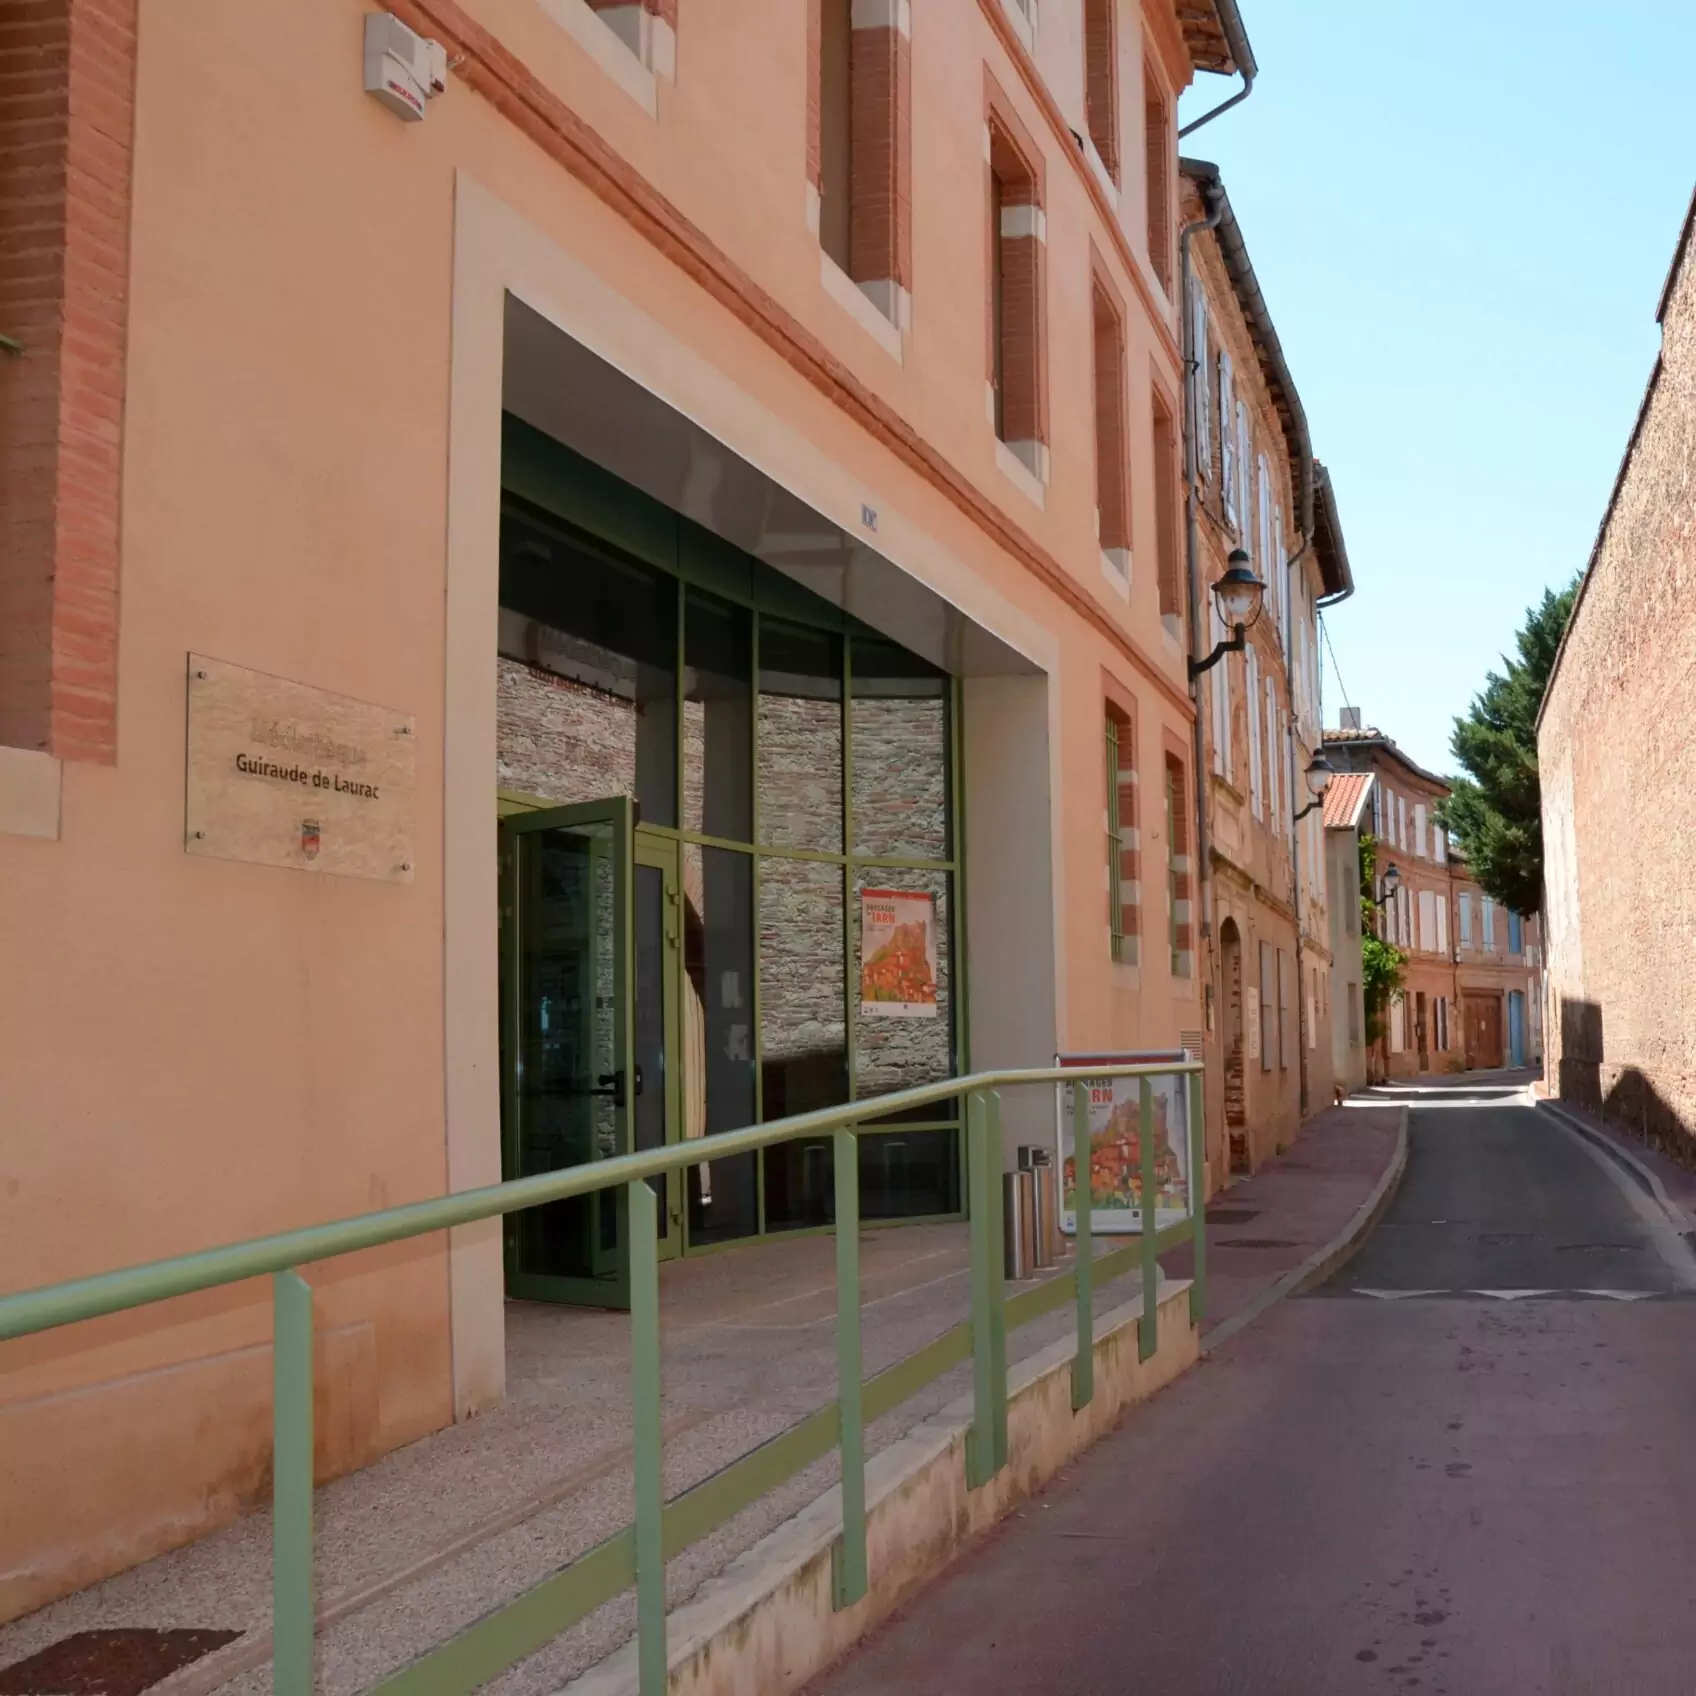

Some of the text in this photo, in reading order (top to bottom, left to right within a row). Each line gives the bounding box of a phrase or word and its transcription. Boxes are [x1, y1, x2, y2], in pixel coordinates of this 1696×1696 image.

[236, 753, 379, 799] Guiraude de Laurac
[872, 911, 895, 924] TARN
